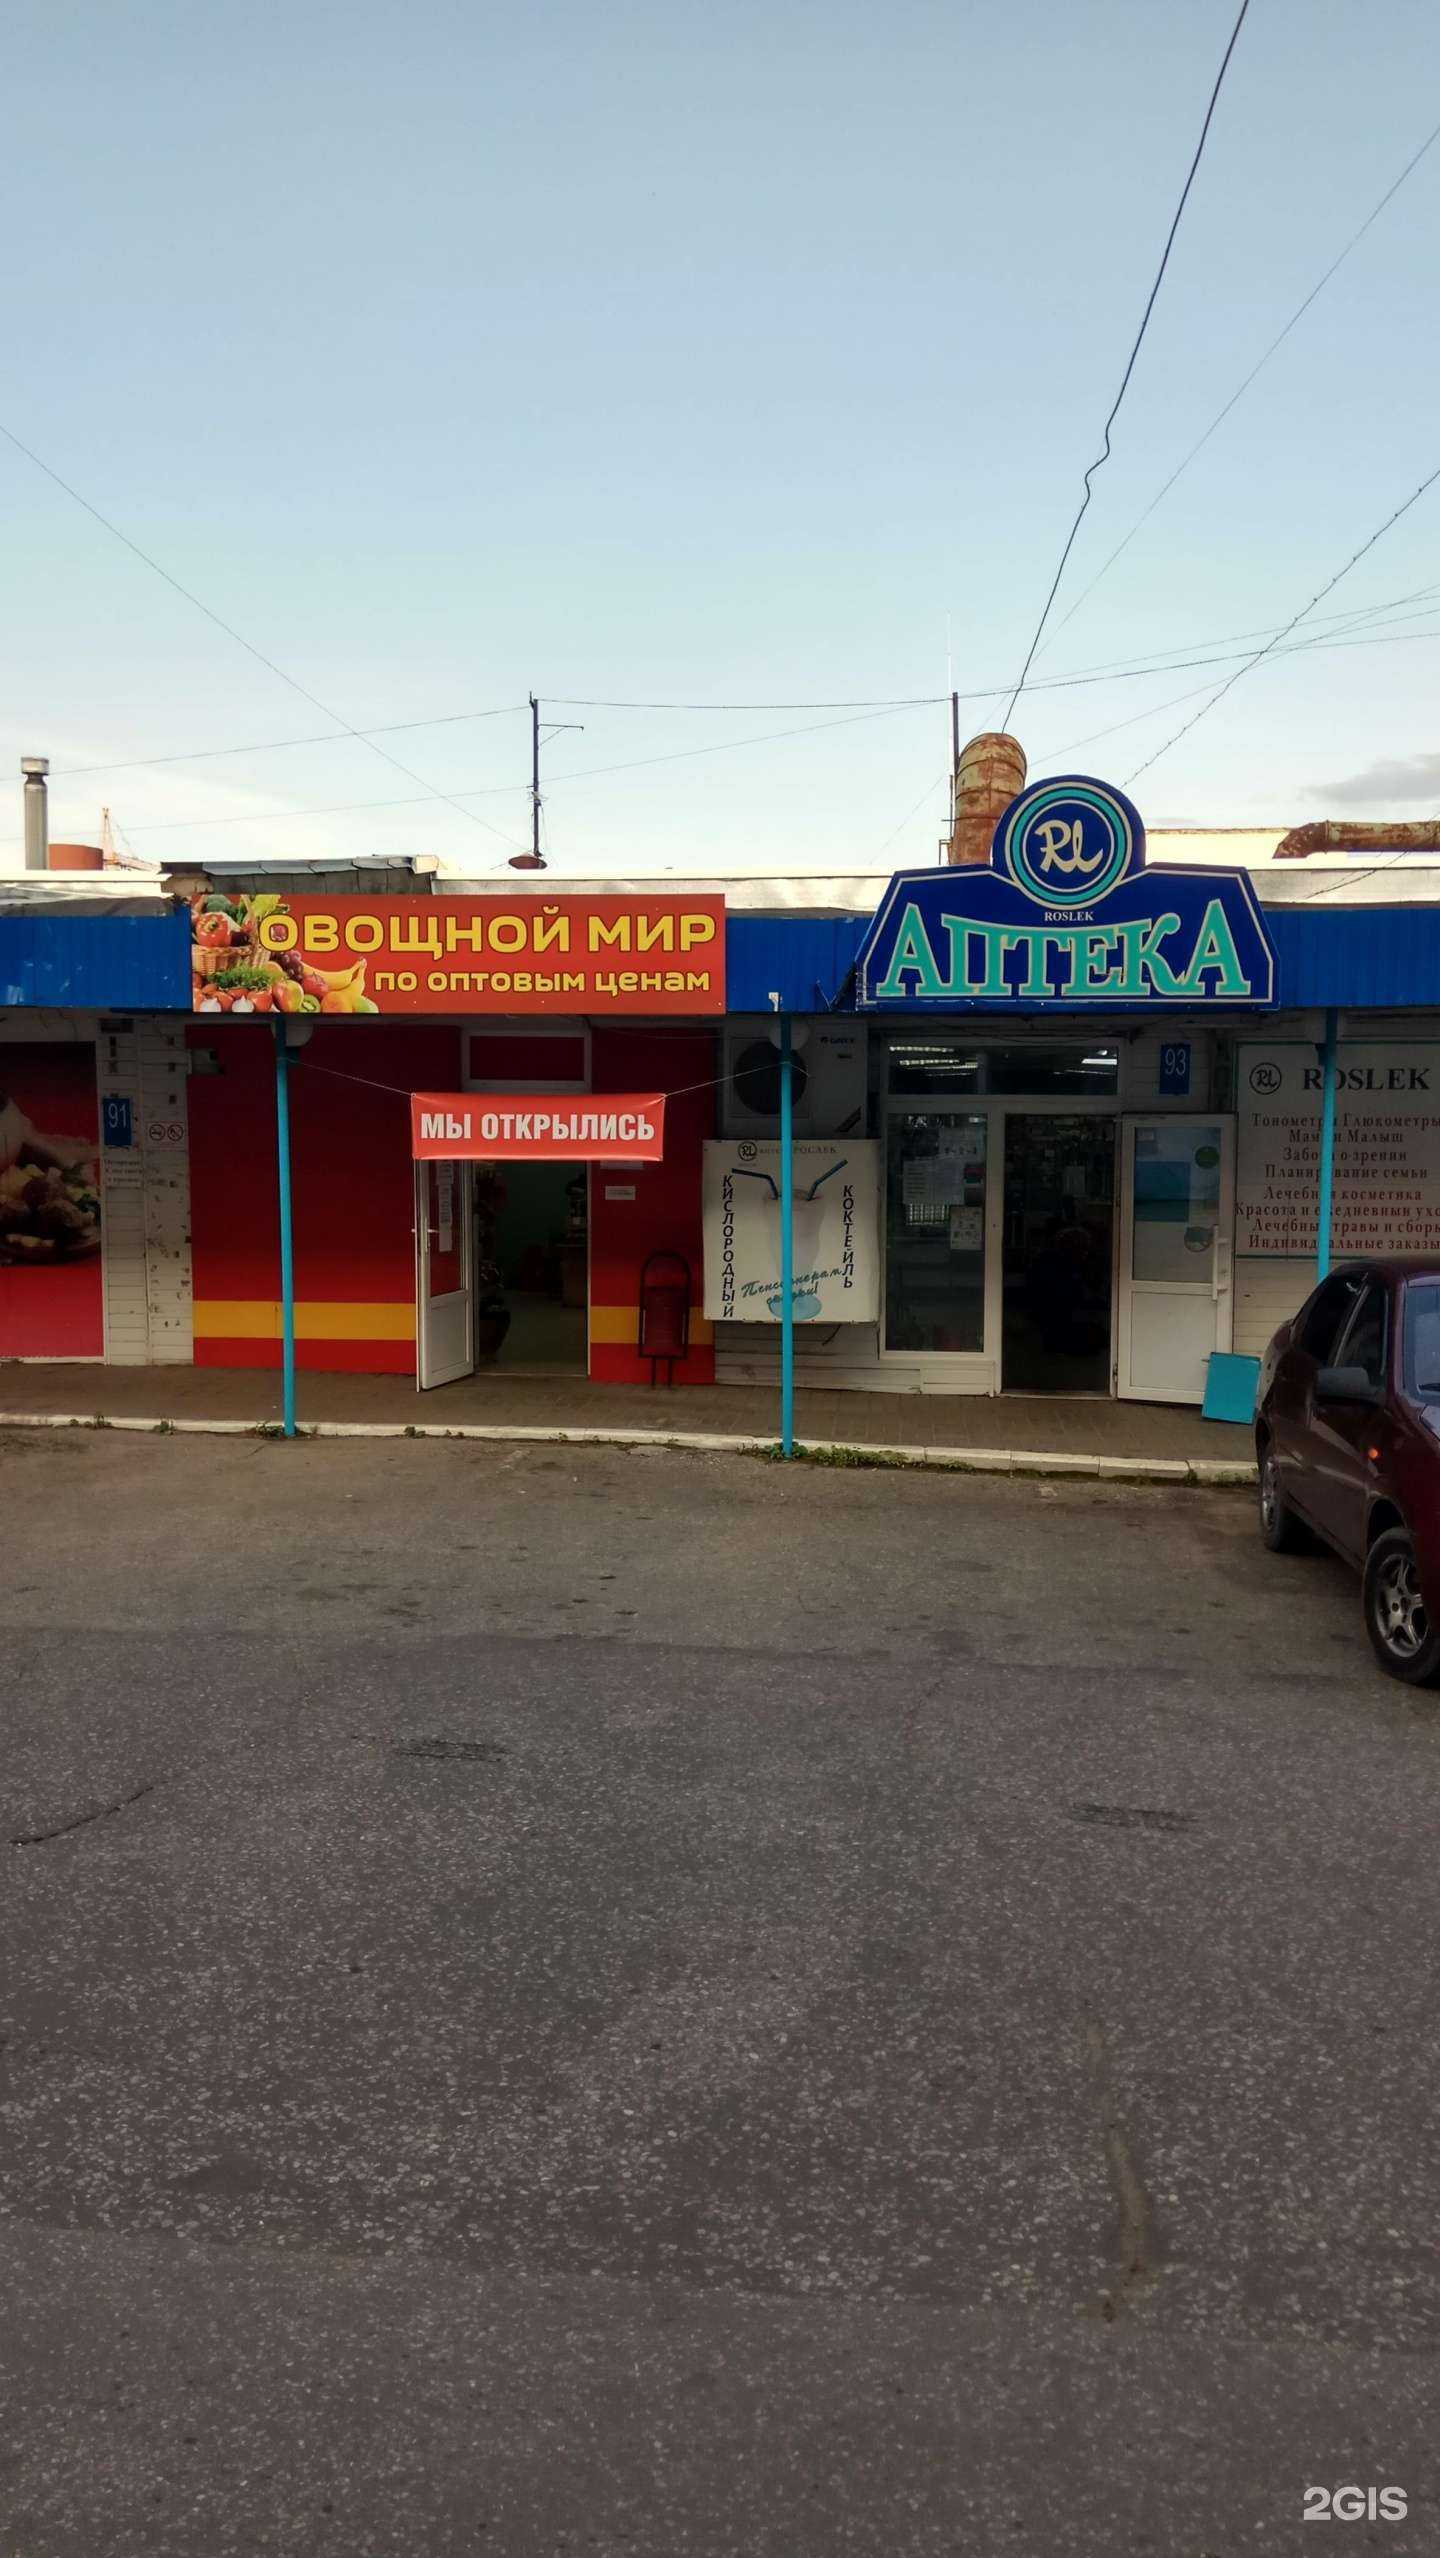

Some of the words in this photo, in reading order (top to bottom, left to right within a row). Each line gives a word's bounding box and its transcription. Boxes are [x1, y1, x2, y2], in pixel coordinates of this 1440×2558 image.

[1044, 911, 1095, 922] ROSLEK
[259, 905, 570, 961] ОВОЩНОЙ
[588, 914, 716, 953] МИР
[876, 898, 1252, 996] АПТЕКА
[374, 970, 418, 993] по
[426, 970, 585, 993] оптовым
[594, 970, 710, 998] ценам
[1165, 1048, 1186, 1076] 93
[108, 1103, 128, 1129] 91
[421, 1113, 472, 1139] МЫ
[481, 1113, 655, 1141] ОТКРЫЛИСЬ
[1289, 1129, 1331, 1143] Мам
[1347, 1129, 1404, 1143] Малыш
[1265, 1164, 1378, 1182] Планирвание
[1383, 1168, 1428, 1179] семьи
[1342, 1190, 1422, 1201] косметика
[842, 1185, 855, 1289] КОКТЕЙЛЬ
[1252, 1219, 1330, 1232] Лечебны
[722, 1175, 735, 1318] КИСЛОРОДНЫЙ
